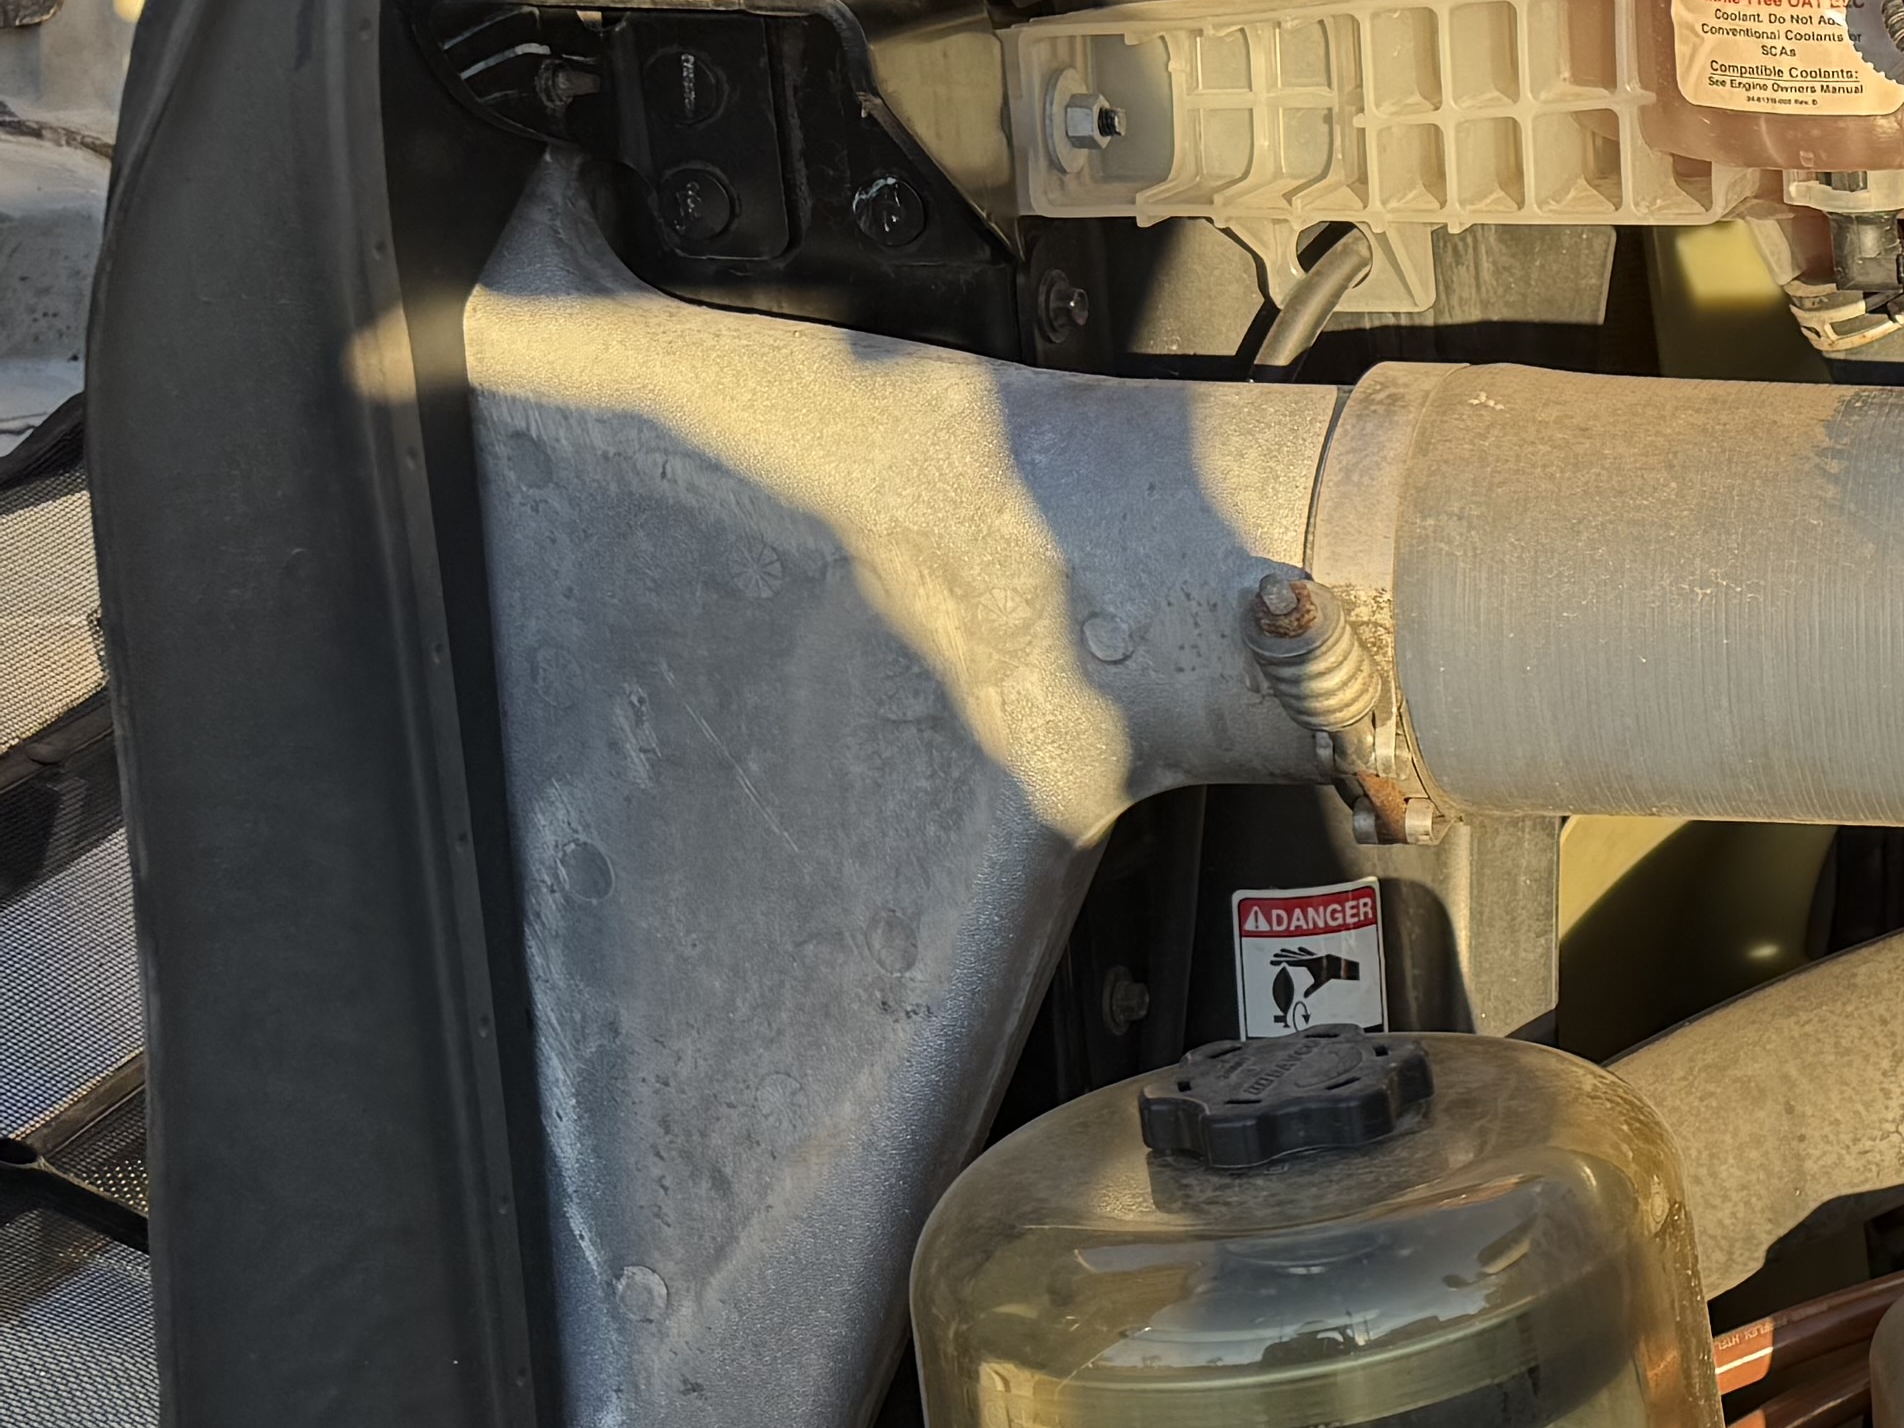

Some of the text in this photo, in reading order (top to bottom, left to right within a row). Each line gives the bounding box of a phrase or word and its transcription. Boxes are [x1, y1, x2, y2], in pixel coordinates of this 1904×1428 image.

[1768, 12, 1787, 26] Do
[1790, 13, 1815, 27] Not
[1701, 23, 1781, 41] Conventional
[1785, 29, 1844, 44] Coolants
[1761, 44, 1798, 58] SCAs
[1710, 59, 1785, 80] Compatible
[1708, 75, 1865, 95] See Engine Owners Manual
[1271, 897, 1374, 931] DANGER
